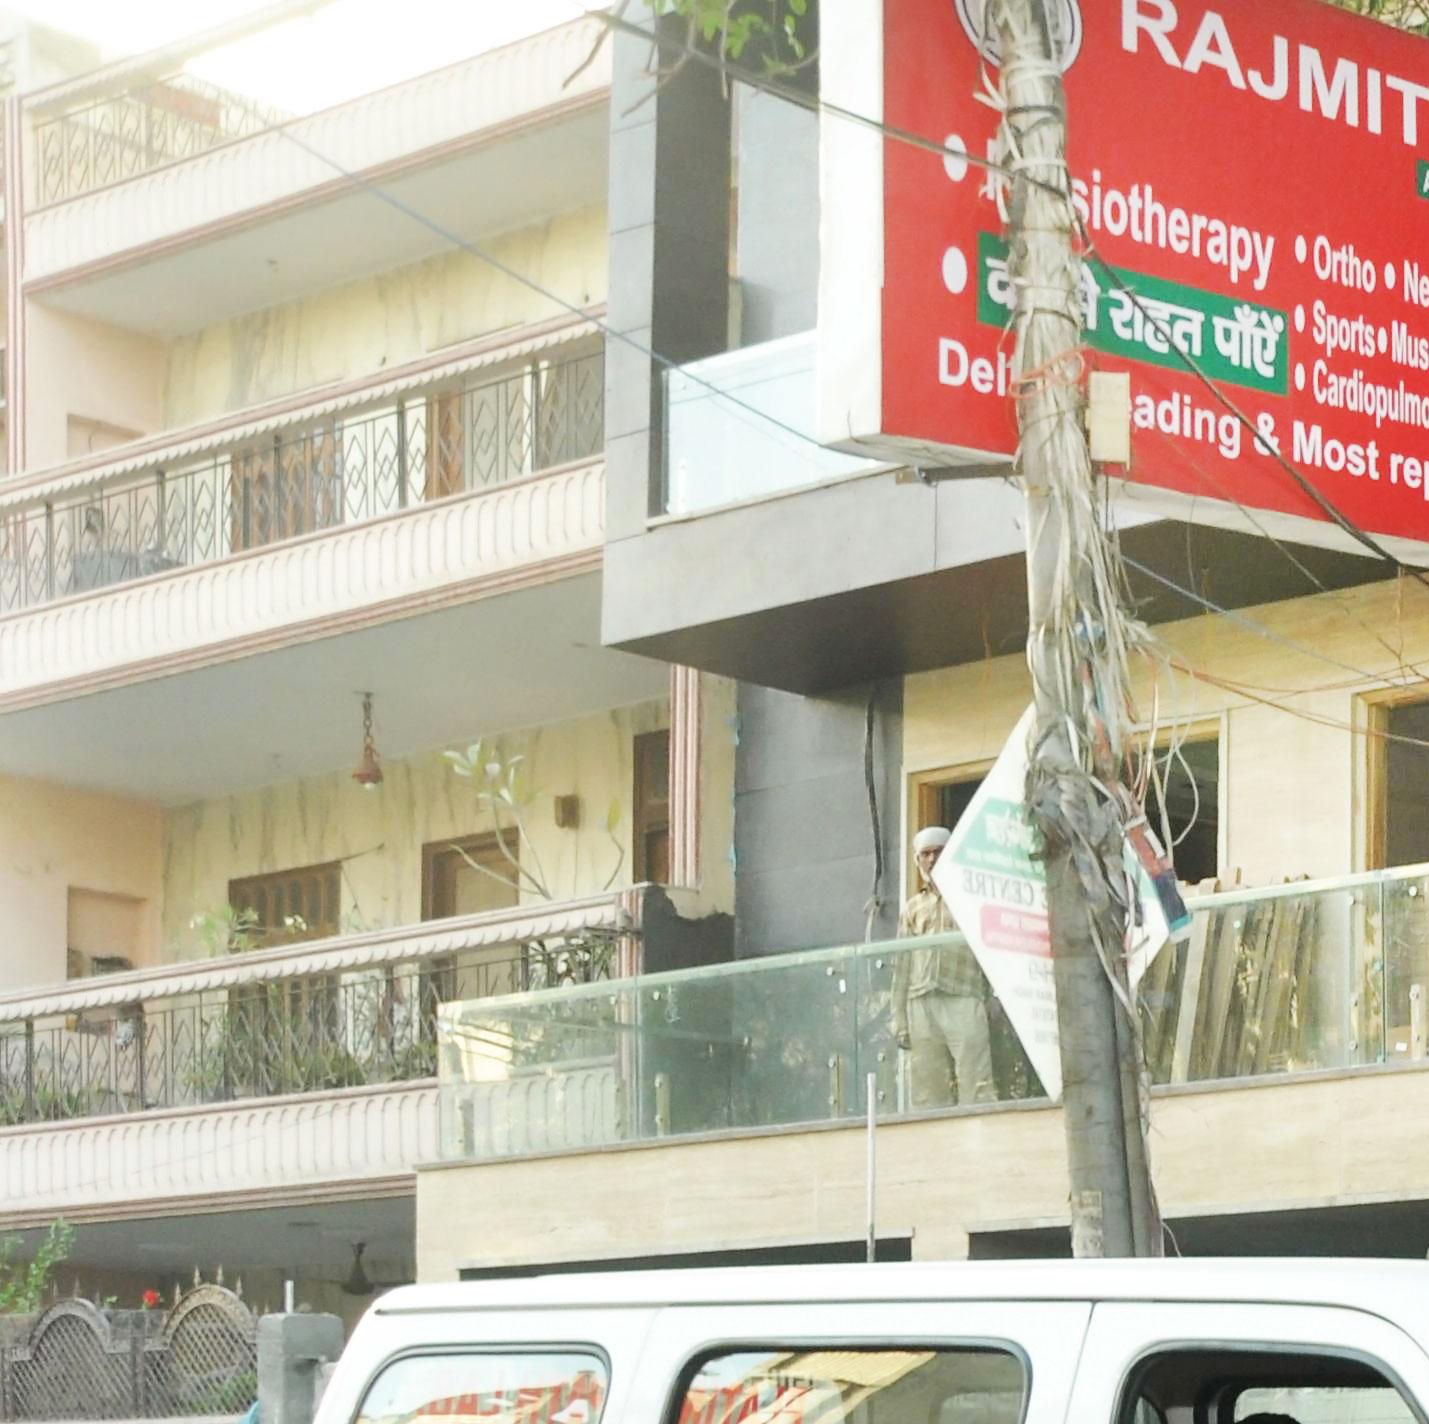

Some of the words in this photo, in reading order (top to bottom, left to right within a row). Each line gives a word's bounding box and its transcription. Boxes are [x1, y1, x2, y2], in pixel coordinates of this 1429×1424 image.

[1313, 235, 1377, 293] Ortho
[1108, 288, 1204, 354] राहत
[1313, 311, 1376, 359] Sports
[1126, 391, 1242, 458] eading
[1254, 412, 1280, 456] &
[1293, 420, 1380, 481] Most
